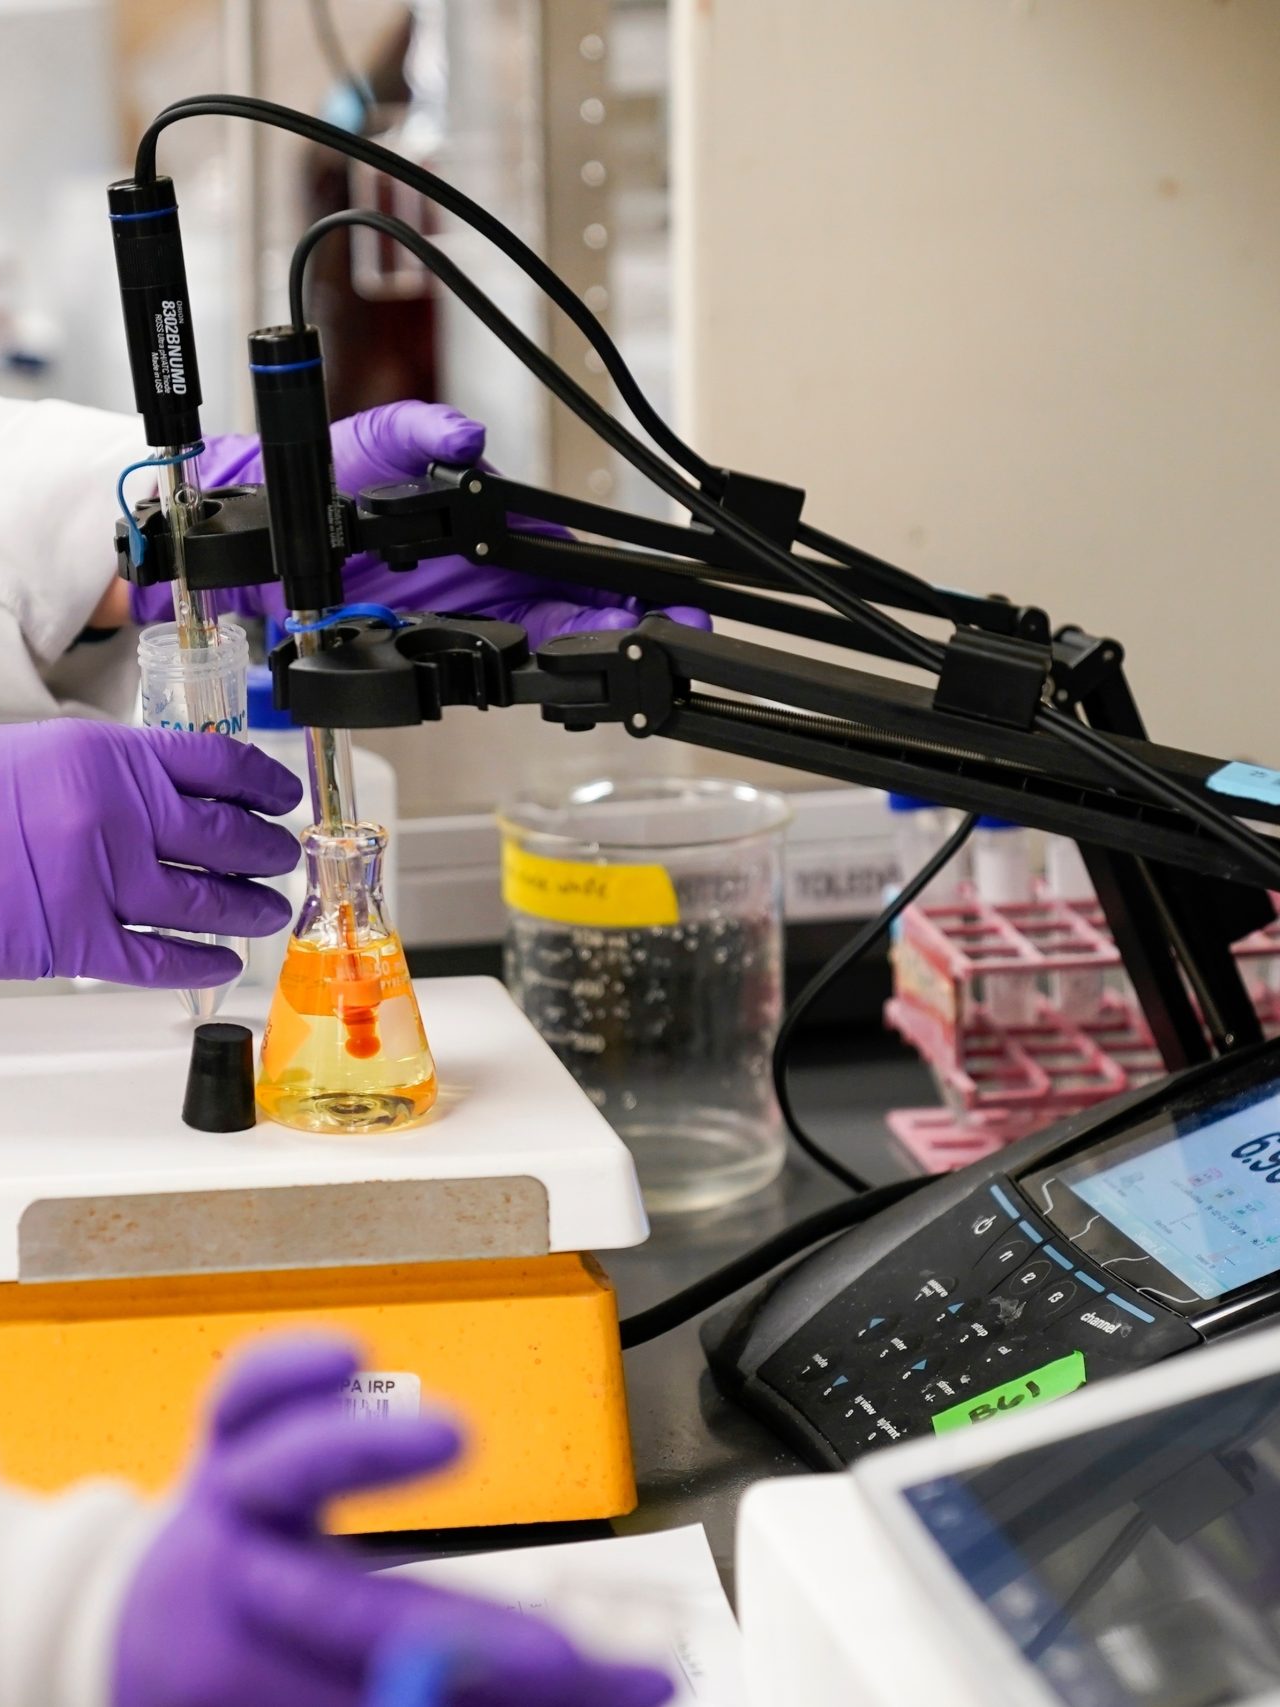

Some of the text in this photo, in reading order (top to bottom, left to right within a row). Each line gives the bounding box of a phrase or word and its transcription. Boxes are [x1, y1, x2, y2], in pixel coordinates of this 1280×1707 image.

[154, 313, 164, 333] ROSS
[161, 300, 187, 395] 8302BNUMD
[151, 351, 160, 371] Made
[154, 379, 164, 394] USA
[1231, 1131, 1280, 1184] 6.9
[999, 1250, 1014, 1263] f1
[1021, 1271, 1037, 1285] f2
[1047, 1291, 1064, 1303] f3
[1080, 1311, 1122, 1335] channel
[880, 1349, 889, 1358] 5
[902, 1371, 911, 1380] 6
[368, 1379, 396, 1393] IRP
[845, 1409, 854, 1418] 9
